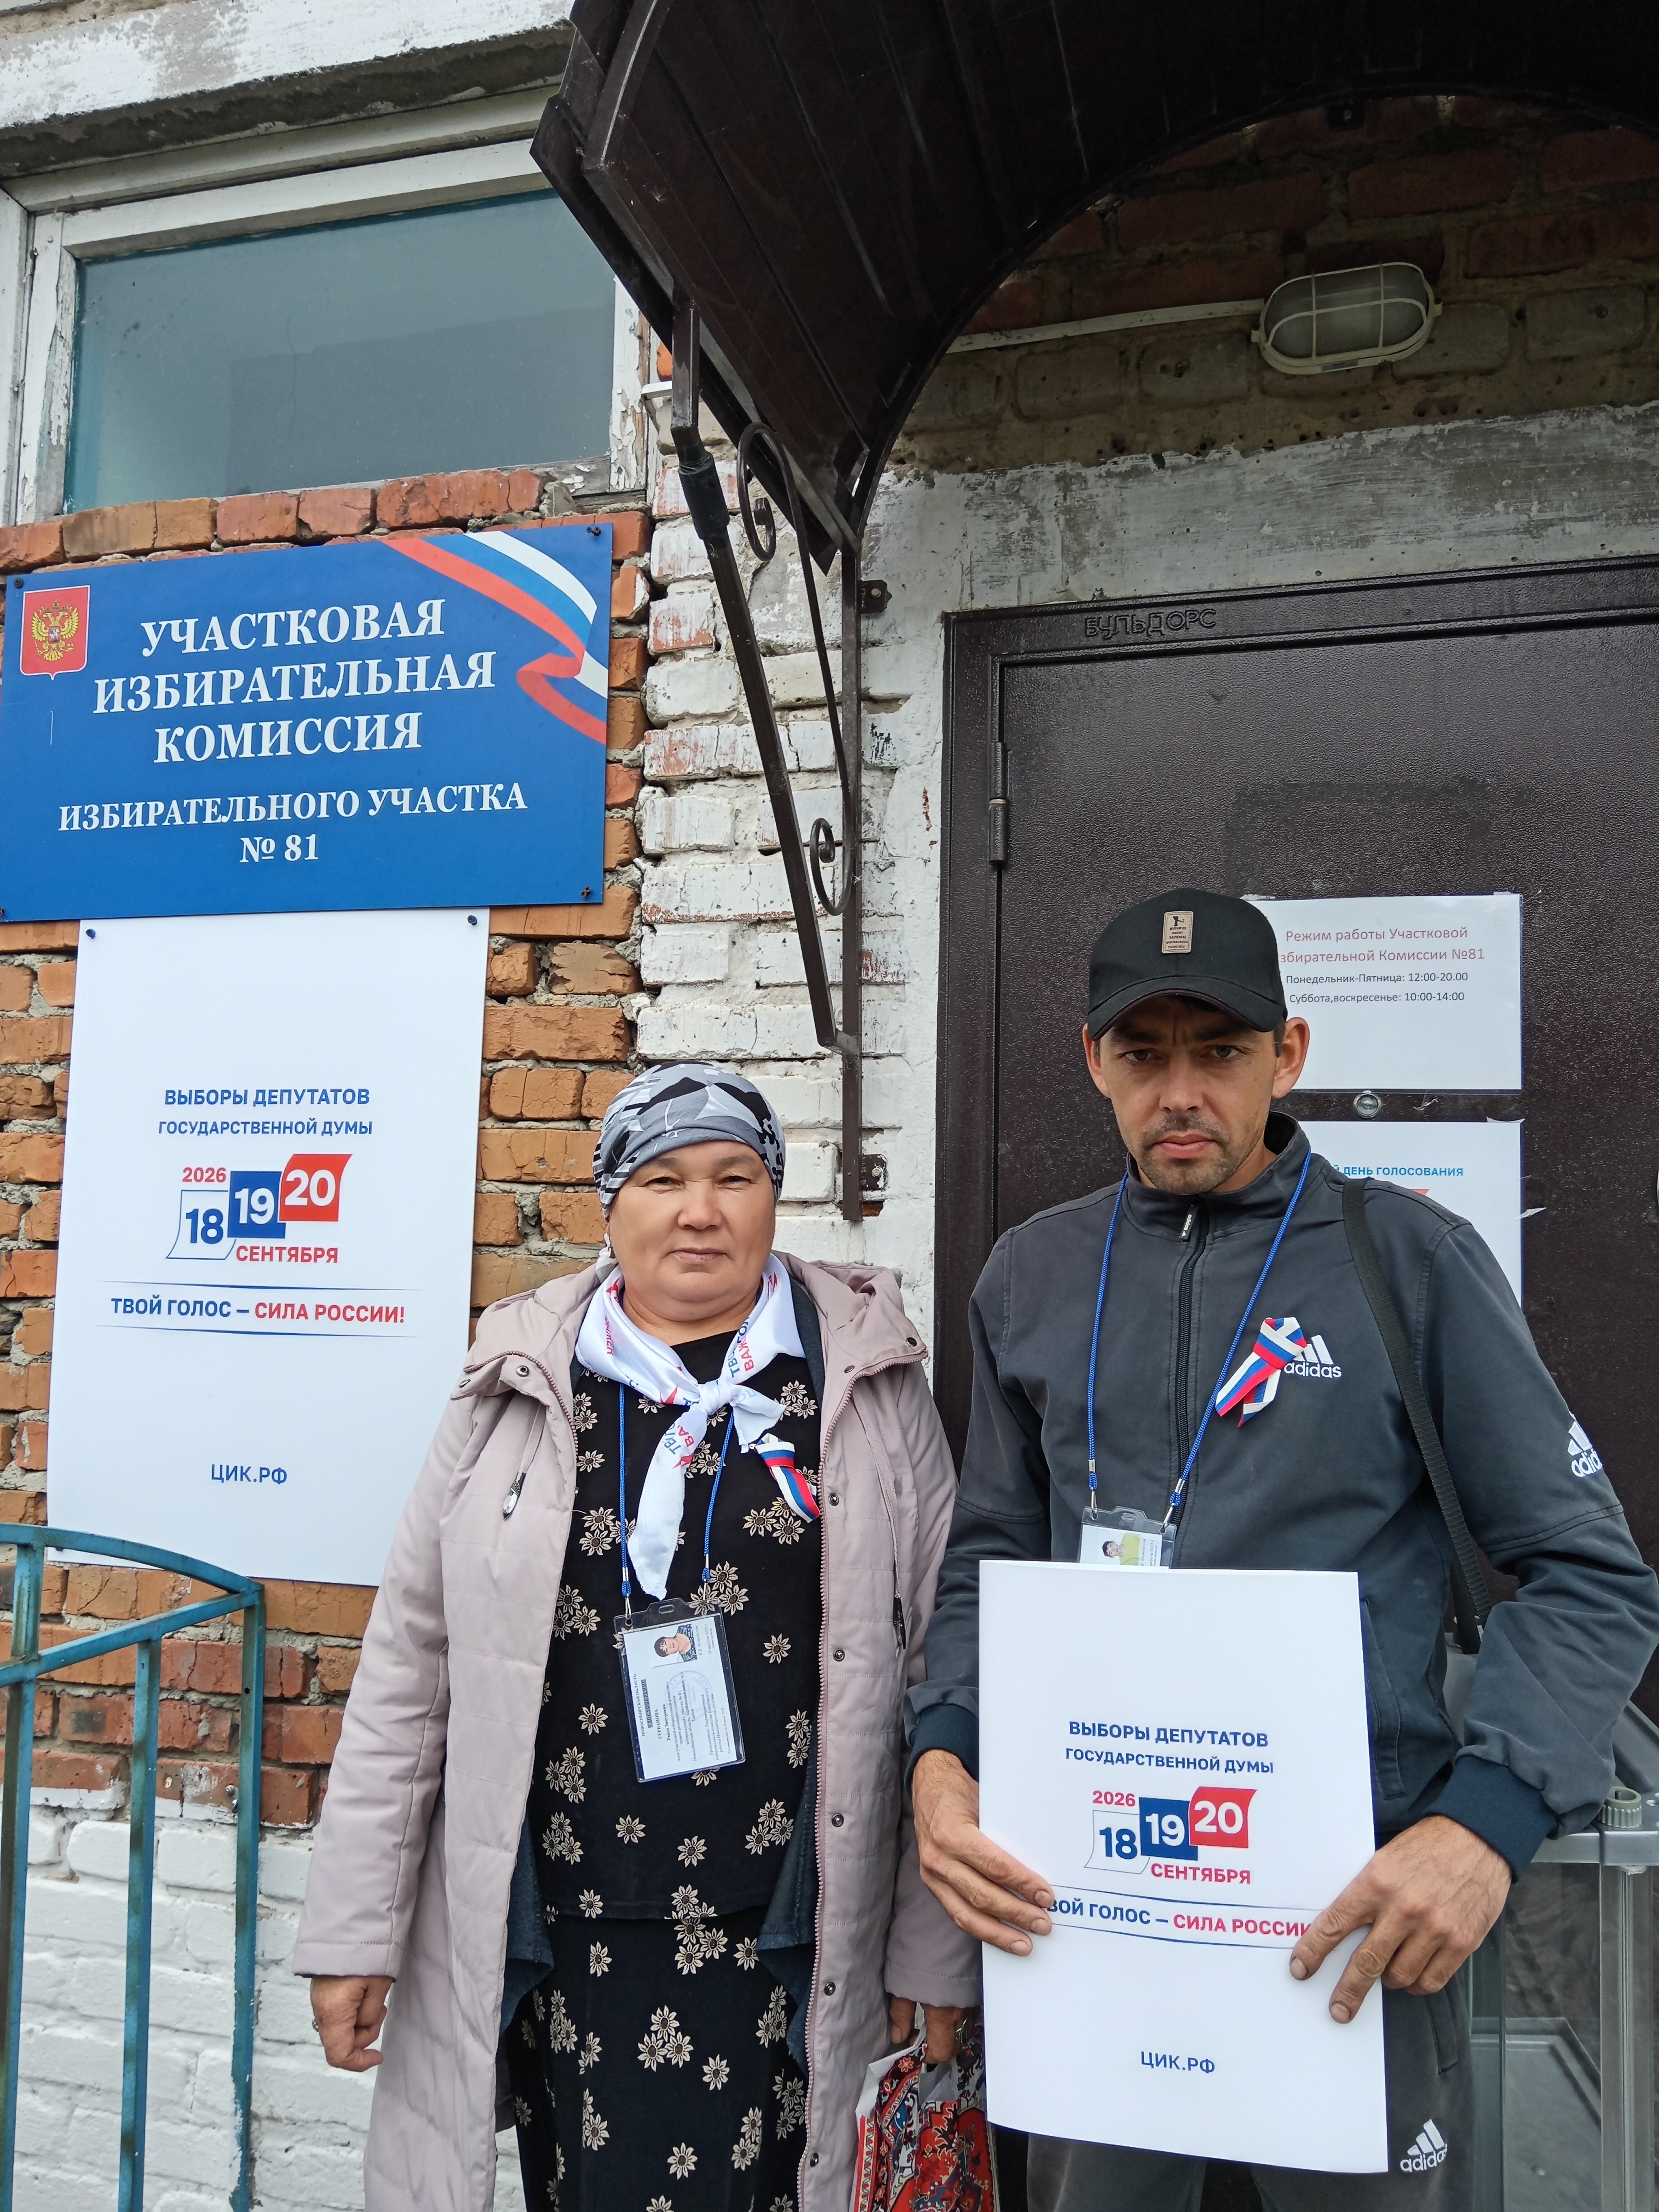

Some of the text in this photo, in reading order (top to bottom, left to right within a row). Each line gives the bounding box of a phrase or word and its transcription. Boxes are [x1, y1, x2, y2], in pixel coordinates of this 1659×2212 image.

[141, 598, 446, 657] УЧАСТКОВАЯ
[1085, 608, 1216, 640] БУЛЬДОРС
[93, 652, 496, 713] ИЗБИРАТЕЛЬНАЯ
[154, 713, 422, 763] КОМИССИЯ
[58, 783, 528, 831] ИЗБИРАТЕЛЬНОГО УЧАСТКА
[239, 834, 319, 863] № 81
[1286, 927, 1467, 942] Режим работы Участковой
[1280, 949, 1484, 964] збирательной Комиссии №81
[1286, 973, 1468, 984] Понедельник-Пятница: 12:00-20.00
[1289, 992, 1464, 1004] Суббота,воскресенье: 10:00-14:00
[165, 1088, 370, 1108] ВЫБОРЫ ДЕПУТАТОВ
[158, 1117, 372, 1137] ГОСУДАРСТВЕННОЙ ДУМЫ
[182, 1167, 226, 1183] 2026
[1344, 1167, 1373, 1176] ДЕНЬ
[1377, 1167, 1463, 1176] ГОЛОСОВАНИЯ
[185, 1169, 336, 1243] 18 19 20
[236, 1246, 338, 1263] СЕНТЯБРЯ
[111, 1295, 162, 1316] ТВОЙ
[167, 1300, 231, 1317] ГОЛОС
[255, 1302, 309, 1319] СИЛА
[315, 1305, 405, 1323] РОССИИ!
[1284, 1362, 1342, 1378] adidas
[211, 1464, 287, 1484] ЦИК.РФ
[1571, 1448, 1603, 1477] adid
[637, 1696, 645, 1736] НОВОСИБИРСКАЯ
[642, 1679, 652, 1728] УДОСТОВЕРЕНИЕ
[1069, 1721, 1268, 1747] ВЫБОРЫ ДЕПУТАТОВ
[1065, 1748, 1274, 1774] ГОСУДАРСТВЕННОЙ ДУМЫ
[1093, 1790, 1136, 1807] 2026
[1099, 1800, 1243, 1860] 18 19 20
[1150, 1863, 1251, 1885] СЕНТЯБРЯ
[1047, 1897, 1083, 1916] ВОЙ
[1090, 1903, 1151, 1925] ГОЛОС
[1173, 1914, 1226, 1933] СИЛА
[1232, 1919, 1311, 1936] РОССИИ
[1140, 2051, 1215, 2073] ЦИК.РФ
[1400, 2143, 1448, 2173] adidas
